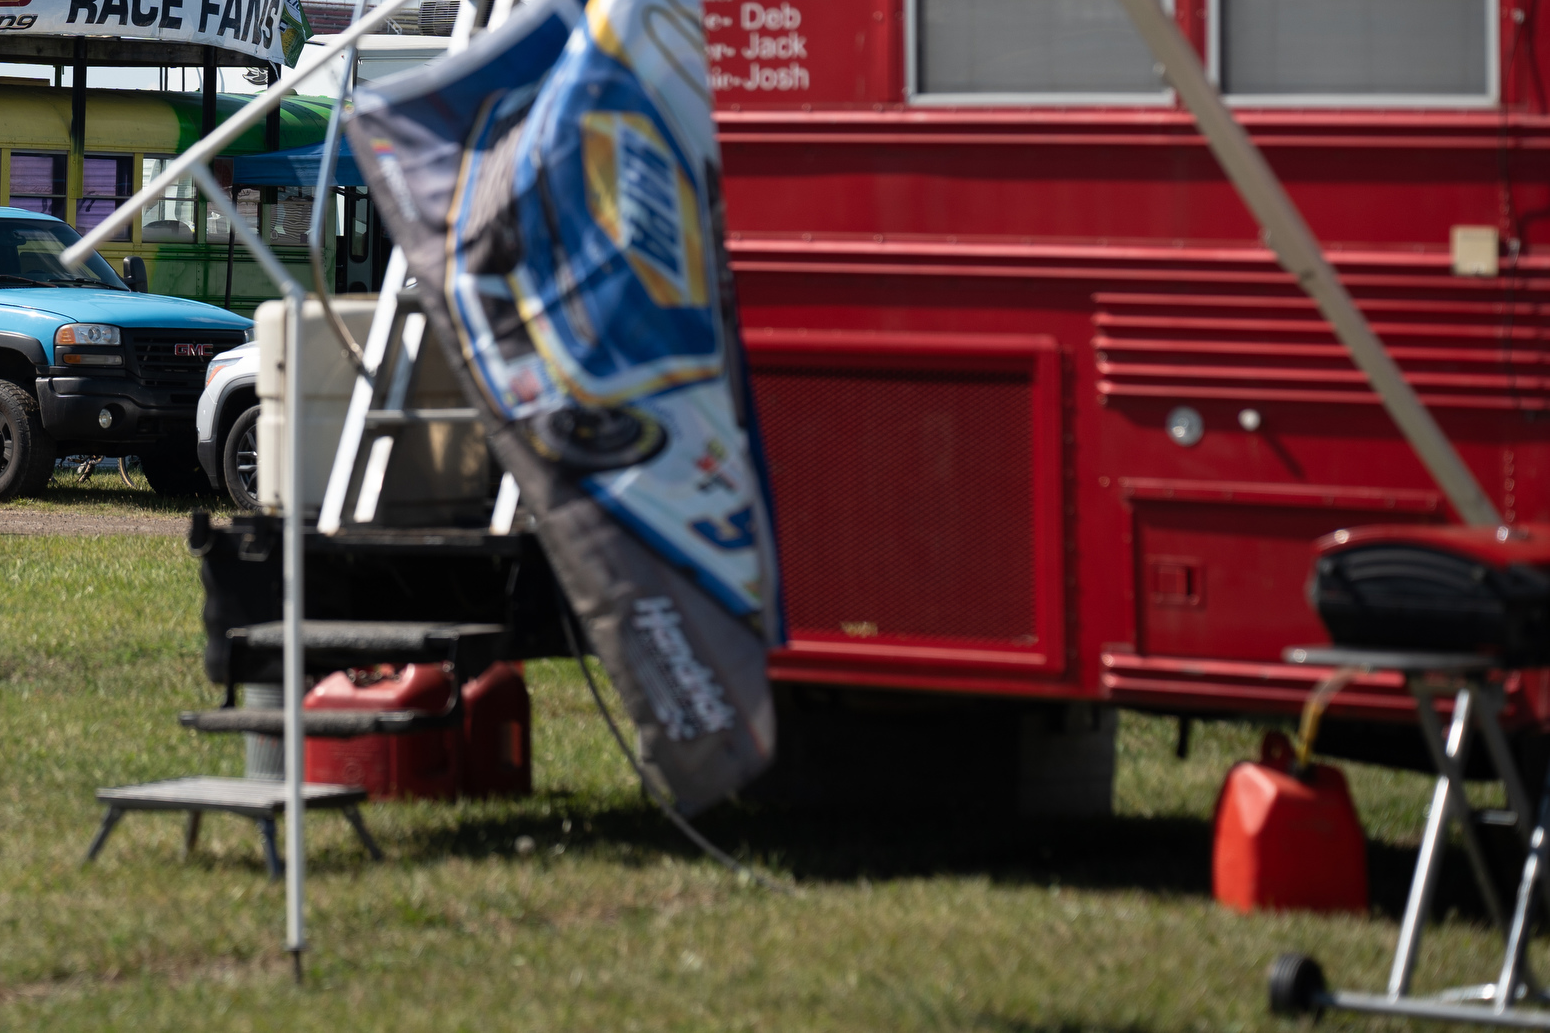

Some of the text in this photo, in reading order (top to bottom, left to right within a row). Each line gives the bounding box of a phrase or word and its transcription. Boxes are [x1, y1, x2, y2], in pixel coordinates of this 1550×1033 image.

[740, 2, 802, 31] Deb
[741, 32, 807, 60] Jack
[742, 62, 810, 91] Josh
[174, 343, 214, 357] GMC
